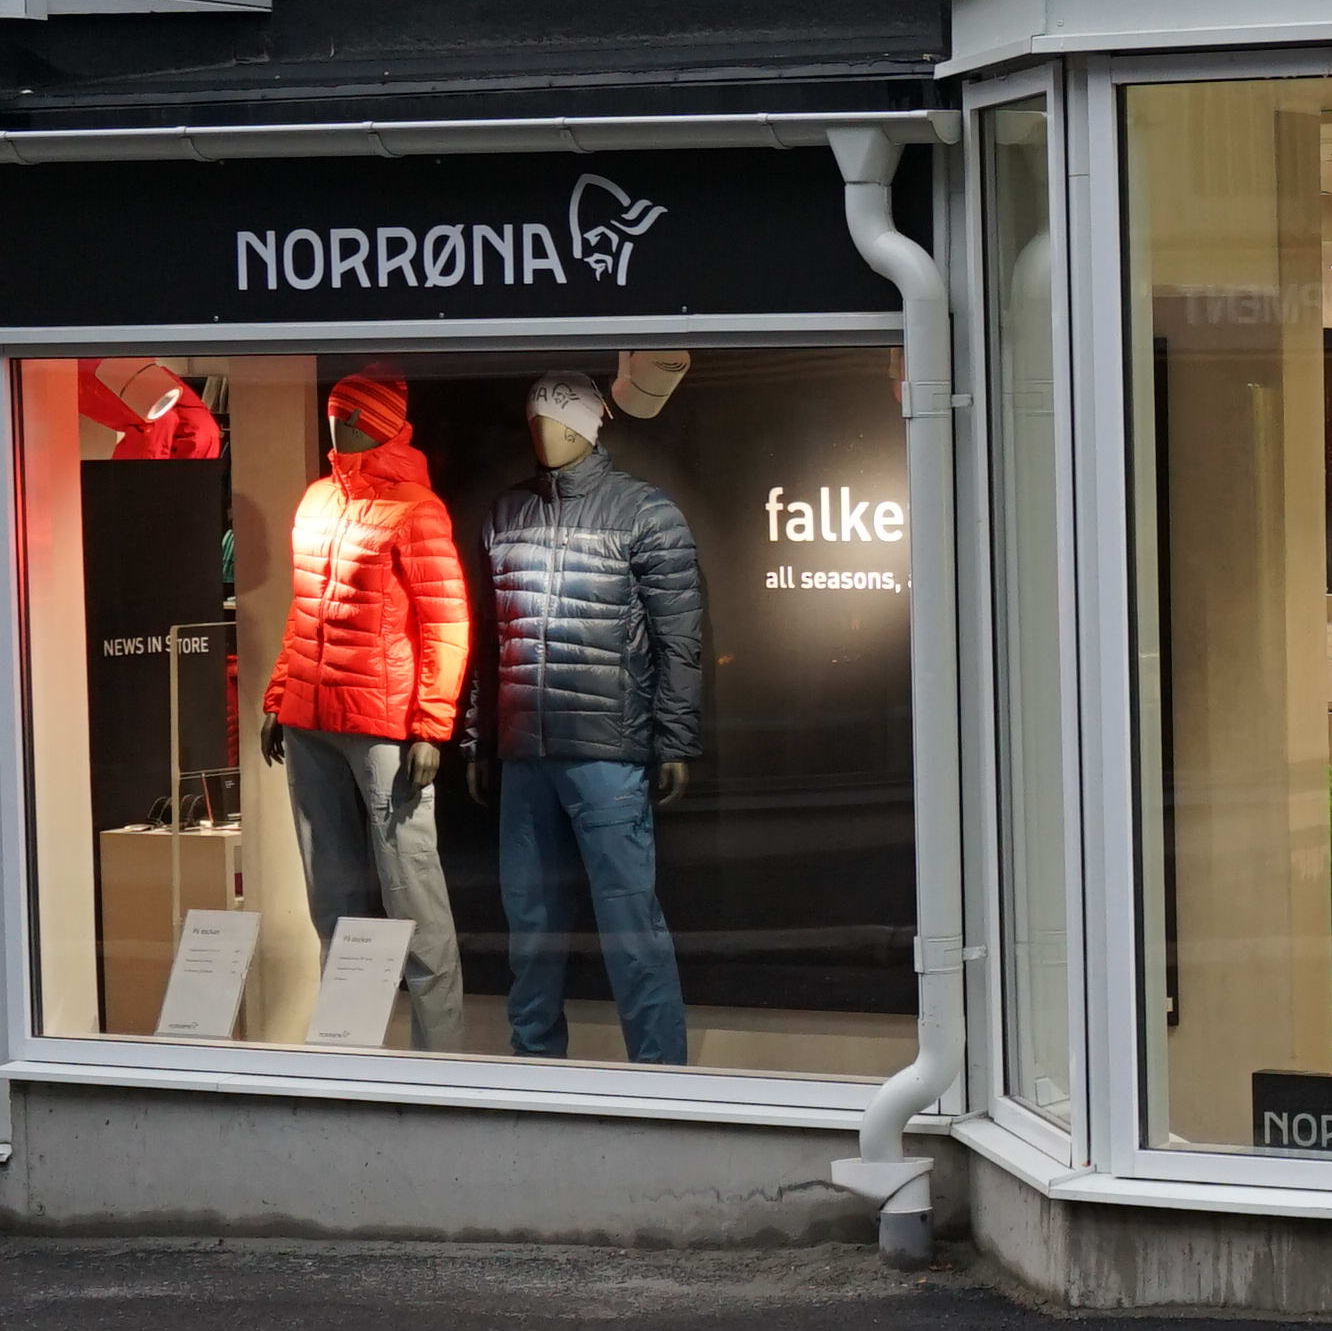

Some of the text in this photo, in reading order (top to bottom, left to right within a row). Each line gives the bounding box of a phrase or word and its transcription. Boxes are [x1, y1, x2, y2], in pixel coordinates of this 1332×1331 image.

[236, 223, 568, 290] NORRØNA
[765, 486, 910, 542] falke
[766, 566, 795, 589] all
[801, 571, 901, 594] seasons,
[103, 637, 144, 657] NEWS
[147, 635, 162, 654] IN
